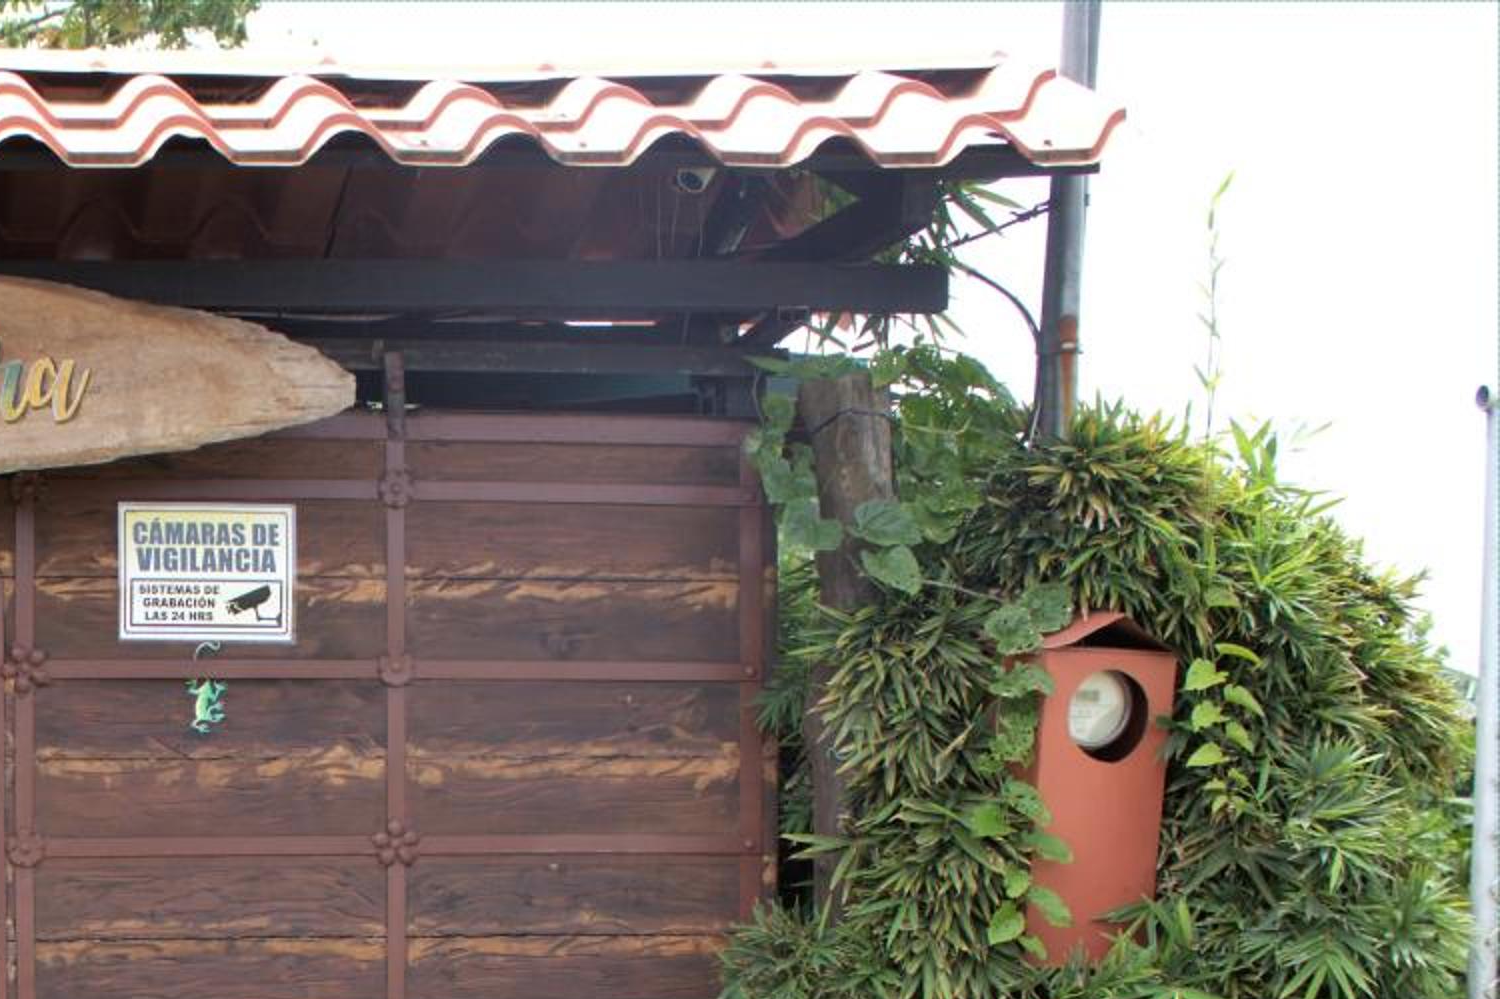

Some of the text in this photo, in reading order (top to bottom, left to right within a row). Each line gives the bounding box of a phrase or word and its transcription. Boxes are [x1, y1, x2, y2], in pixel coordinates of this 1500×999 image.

[133, 517, 280, 547] CÁMARAS DE
[136, 547, 277, 573] VIGILANCIA
[139, 584, 220, 595] SISTEMAS DE
[143, 597, 216, 609] GRABACIÓN
[145, 611, 214, 621] LAS 24 HRS
